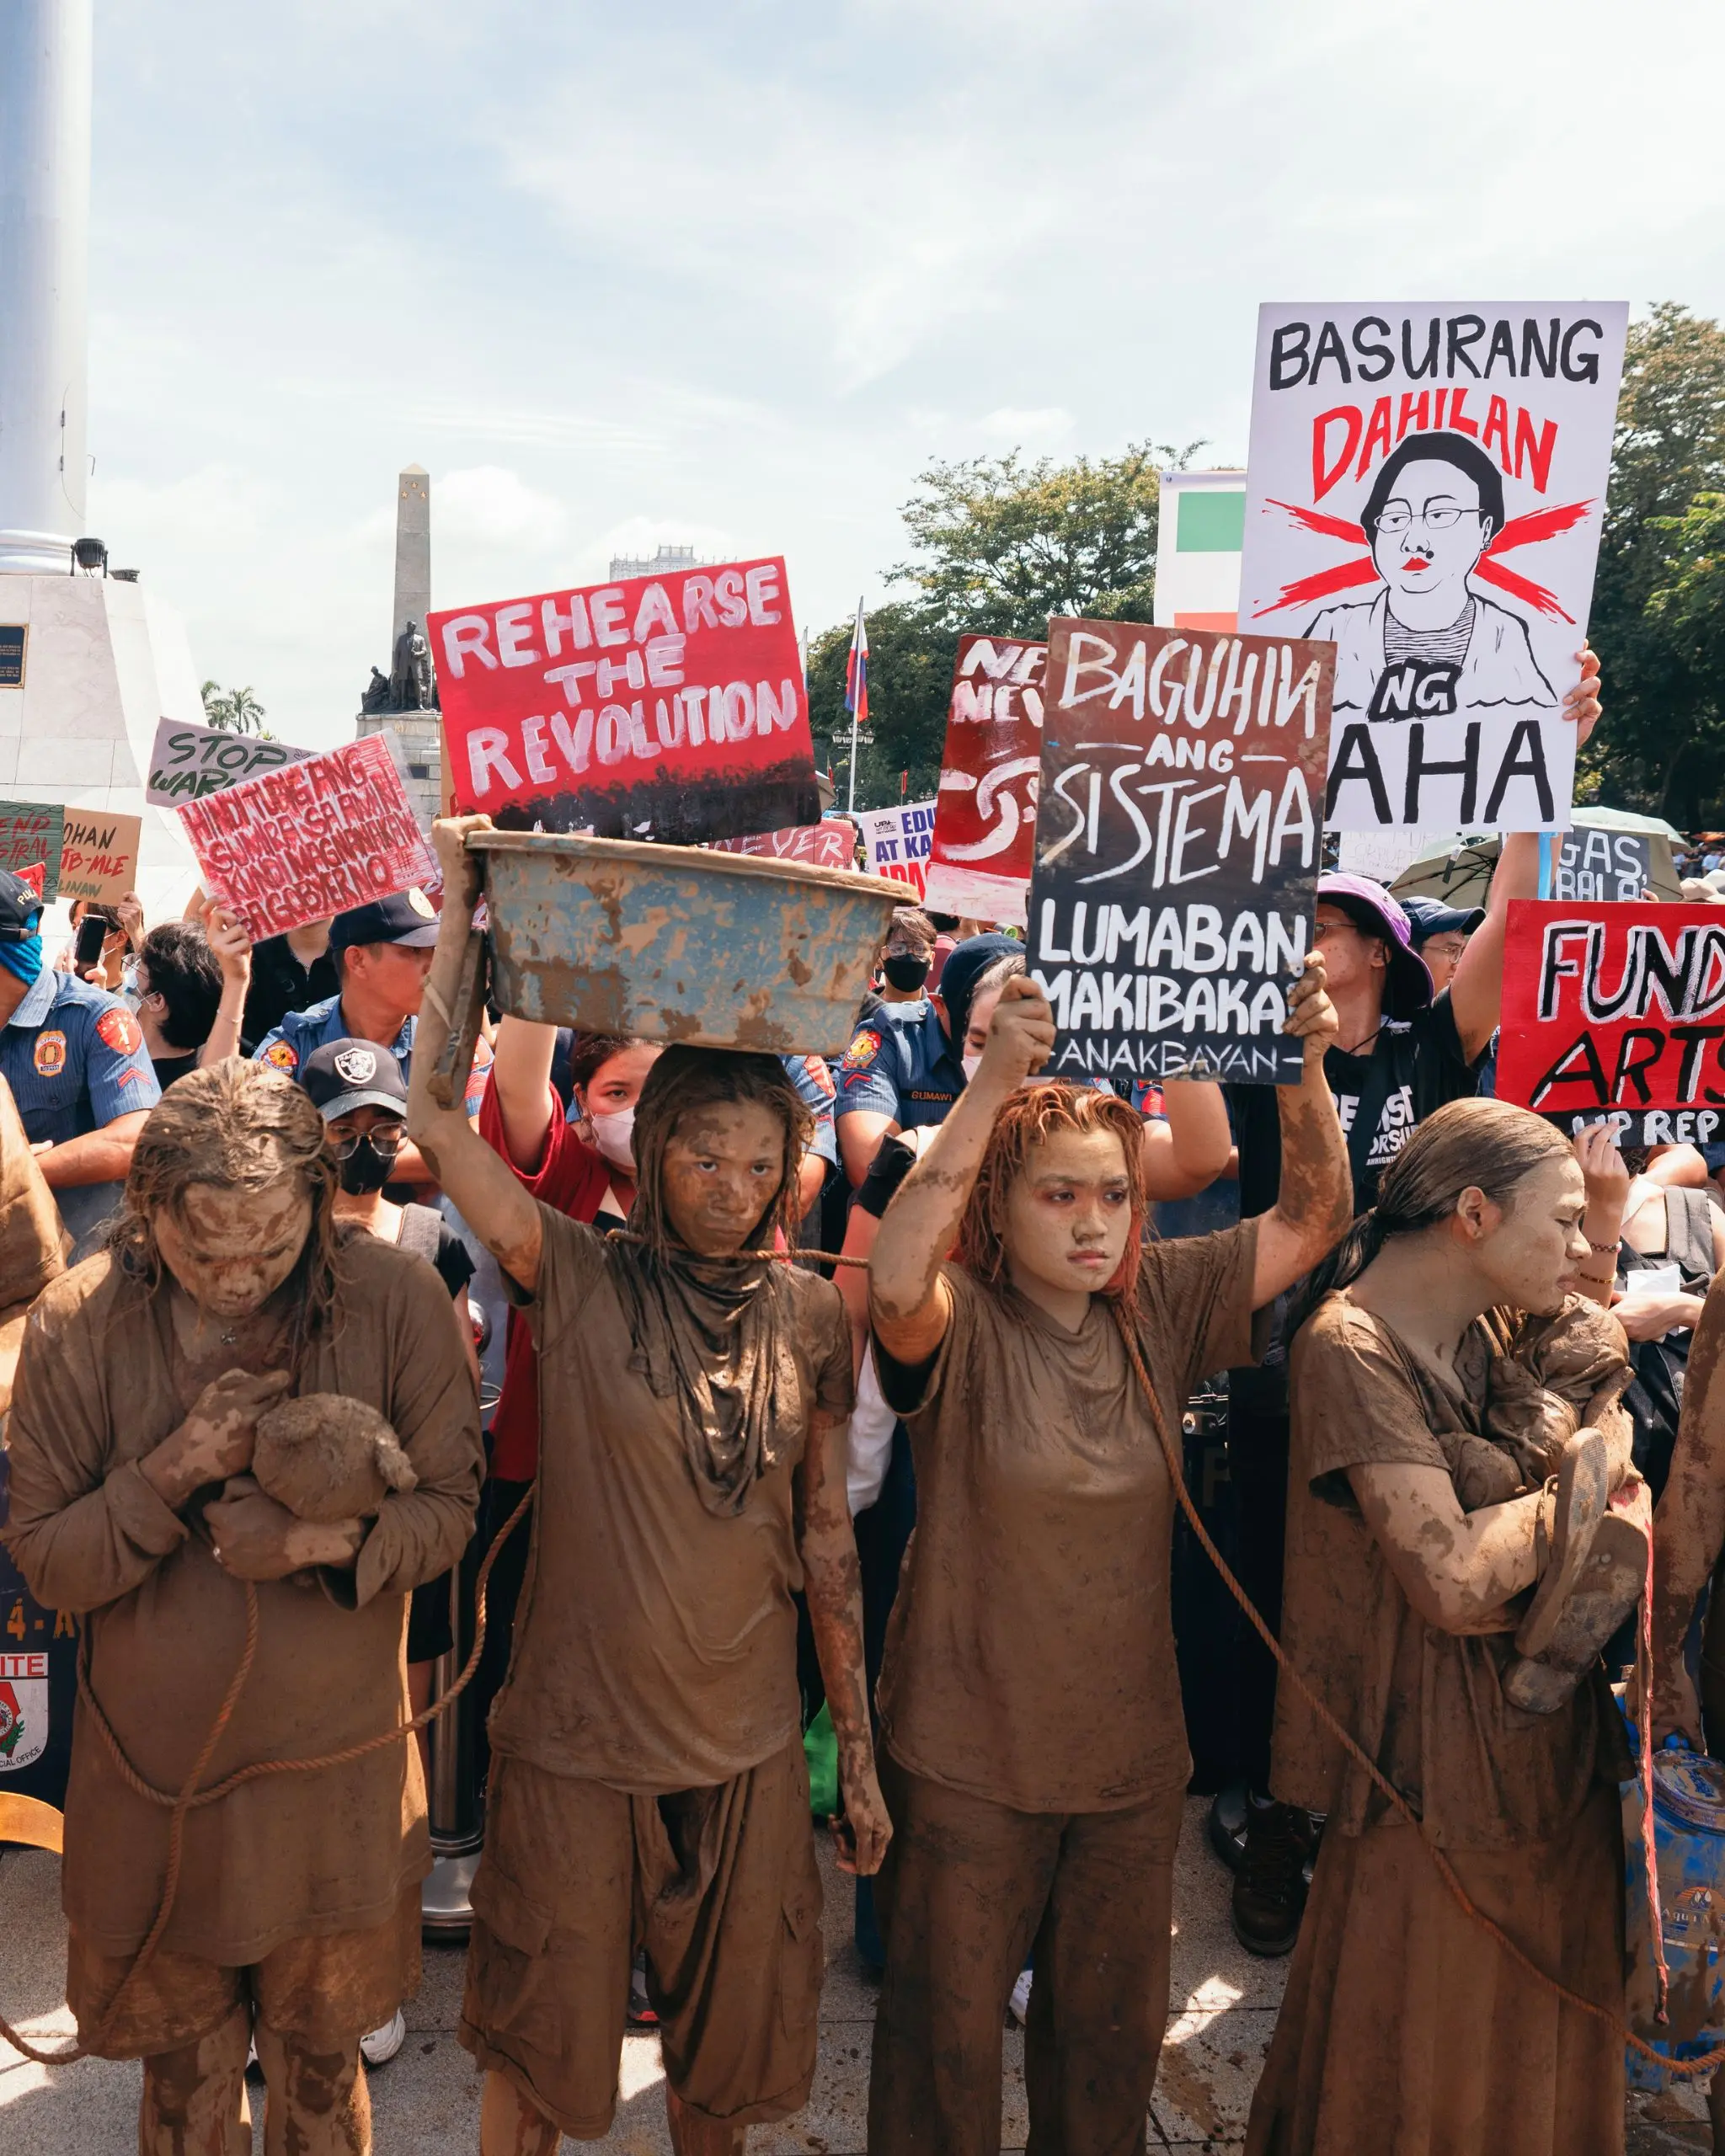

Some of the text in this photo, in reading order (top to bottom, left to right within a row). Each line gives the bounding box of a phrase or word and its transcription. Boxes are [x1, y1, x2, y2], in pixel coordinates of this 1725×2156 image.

[1269, 315, 1603, 390] BASURANG
[1312, 388, 1558, 504] DAHILAN
[442, 565, 781, 679] REHEARSE
[544, 633, 686, 707] THE
[960, 639, 1048, 684] NE
[1056, 632, 1322, 739] BAGUHIN
[1377, 667, 1450, 714] NG
[168, 733, 288, 773] STOP
[467, 678, 798, 798] REVOLUTION
[1145, 733, 1233, 771] ANG
[1325, 720, 1555, 825] AHA
[148, 768, 238, 799] WAR
[179, 786, 251, 845] HINDI
[306, 748, 368, 801] ANG
[876, 839, 899, 862] AT
[1040, 762, 1314, 890] SISTEMA
[1039, 899, 1306, 976] LUMABAN
[1537, 920, 1725, 1024] FUND
[16, 1746, 42, 1764] OFFICE
